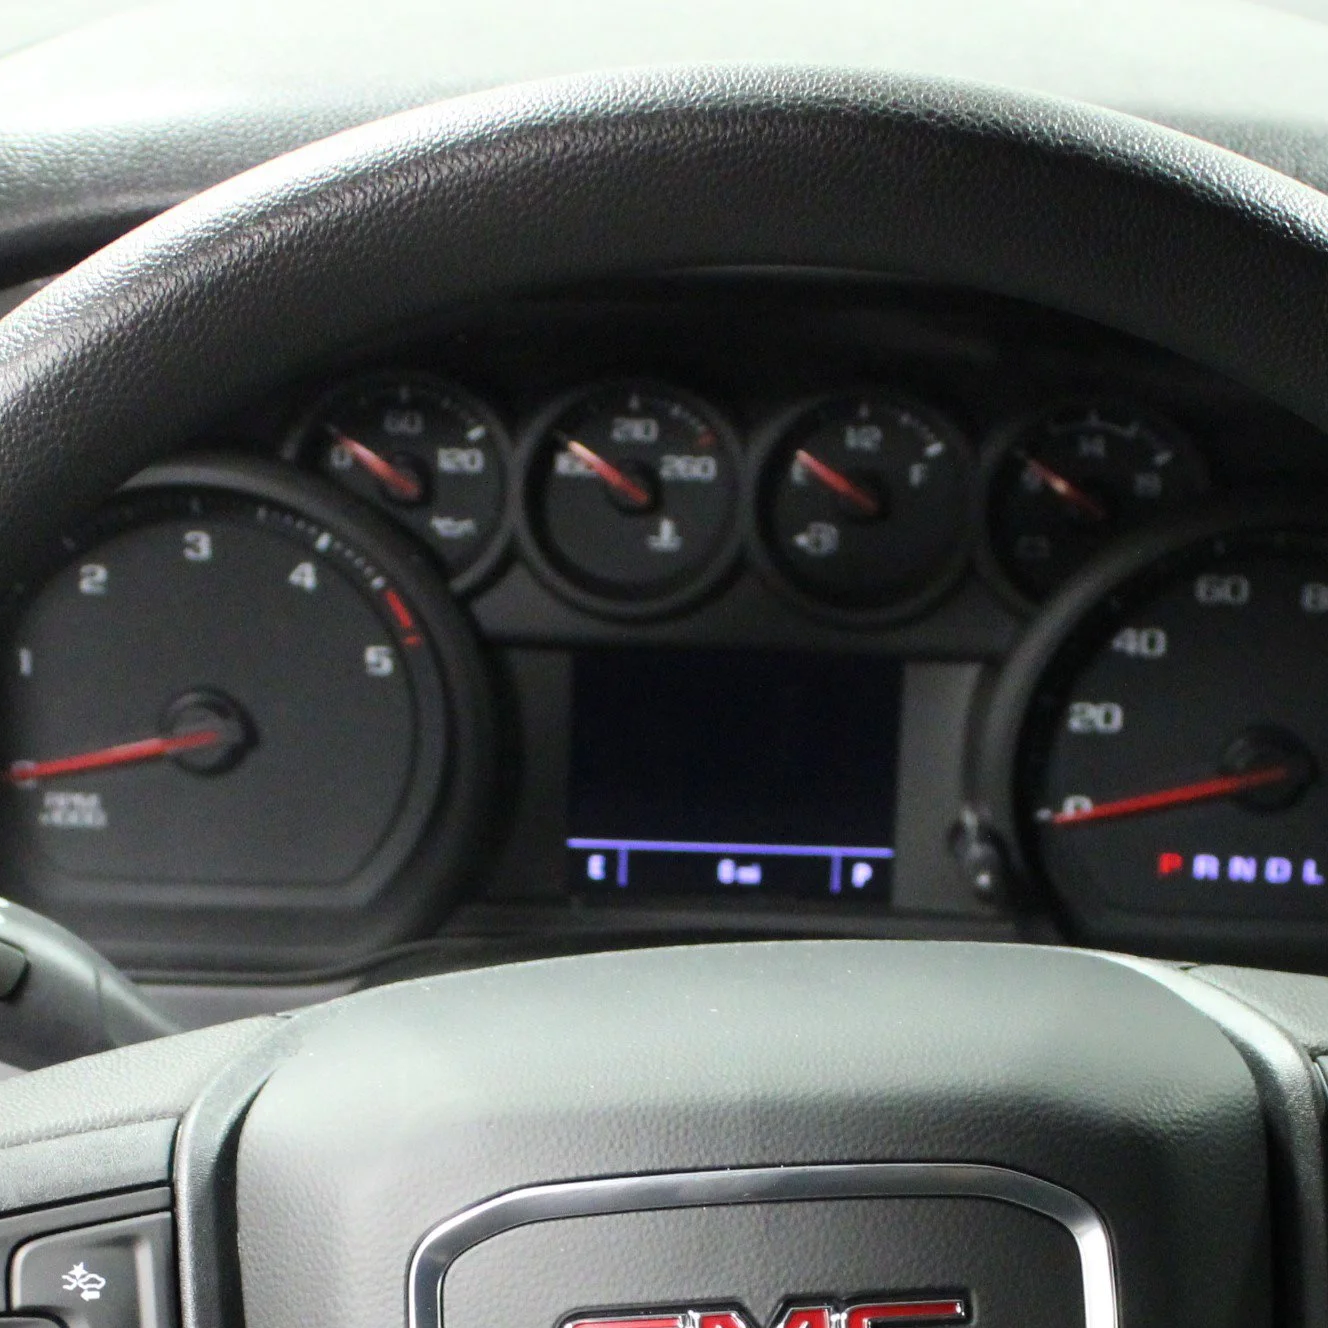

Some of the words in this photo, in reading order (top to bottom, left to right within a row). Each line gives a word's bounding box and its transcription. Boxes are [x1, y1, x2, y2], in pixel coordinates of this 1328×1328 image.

[183, 530, 212, 560] 3
[79, 564, 108, 593] 2
[289, 561, 318, 591] 4
[1194, 574, 1250, 605] 60
[1113, 627, 1167, 658] 40
[364, 646, 394, 677] 5
[1068, 703, 1124, 733] 20
[1158, 852, 1184, 877] P
[1192, 853, 1221, 881] R
[1227, 854, 1258, 883] N
[1264, 855, 1293, 885] D
[1301, 857, 1326, 886] L
